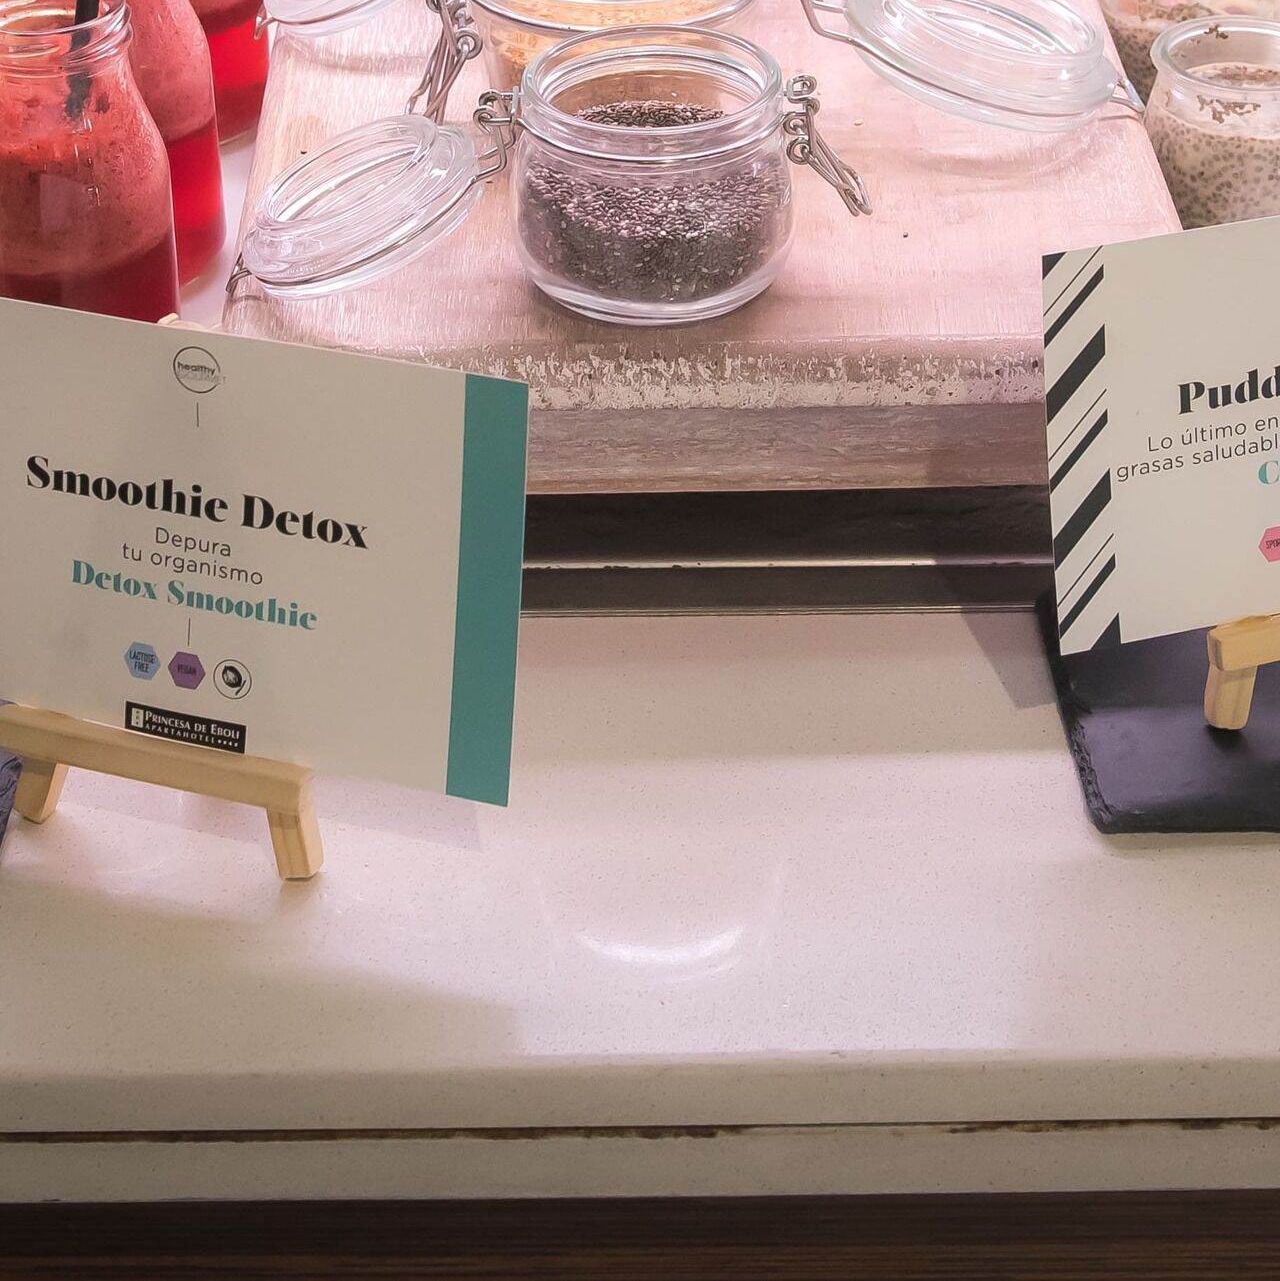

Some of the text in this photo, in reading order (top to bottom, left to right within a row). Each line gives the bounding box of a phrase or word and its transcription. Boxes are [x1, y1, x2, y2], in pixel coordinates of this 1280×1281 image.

[177, 361, 216, 377] healthy
[1147, 435, 1173, 452] Lo
[1181, 422, 1247, 446] último
[1255, 416, 1279, 432] en
[1116, 454, 1185, 483] grasas
[26, 455, 369, 550] Smoothie Detox
[155, 526, 232, 557] Depura
[122, 542, 263, 586] tu organismo
[72, 559, 318, 630] Detox Smoothie
[129, 650, 155, 665] LACTOSE
[134, 661, 150, 673] FREE
[144, 723, 216, 745] APARTAHOTEL
[145, 710, 240, 740] PRINCESA DE EBOLI
